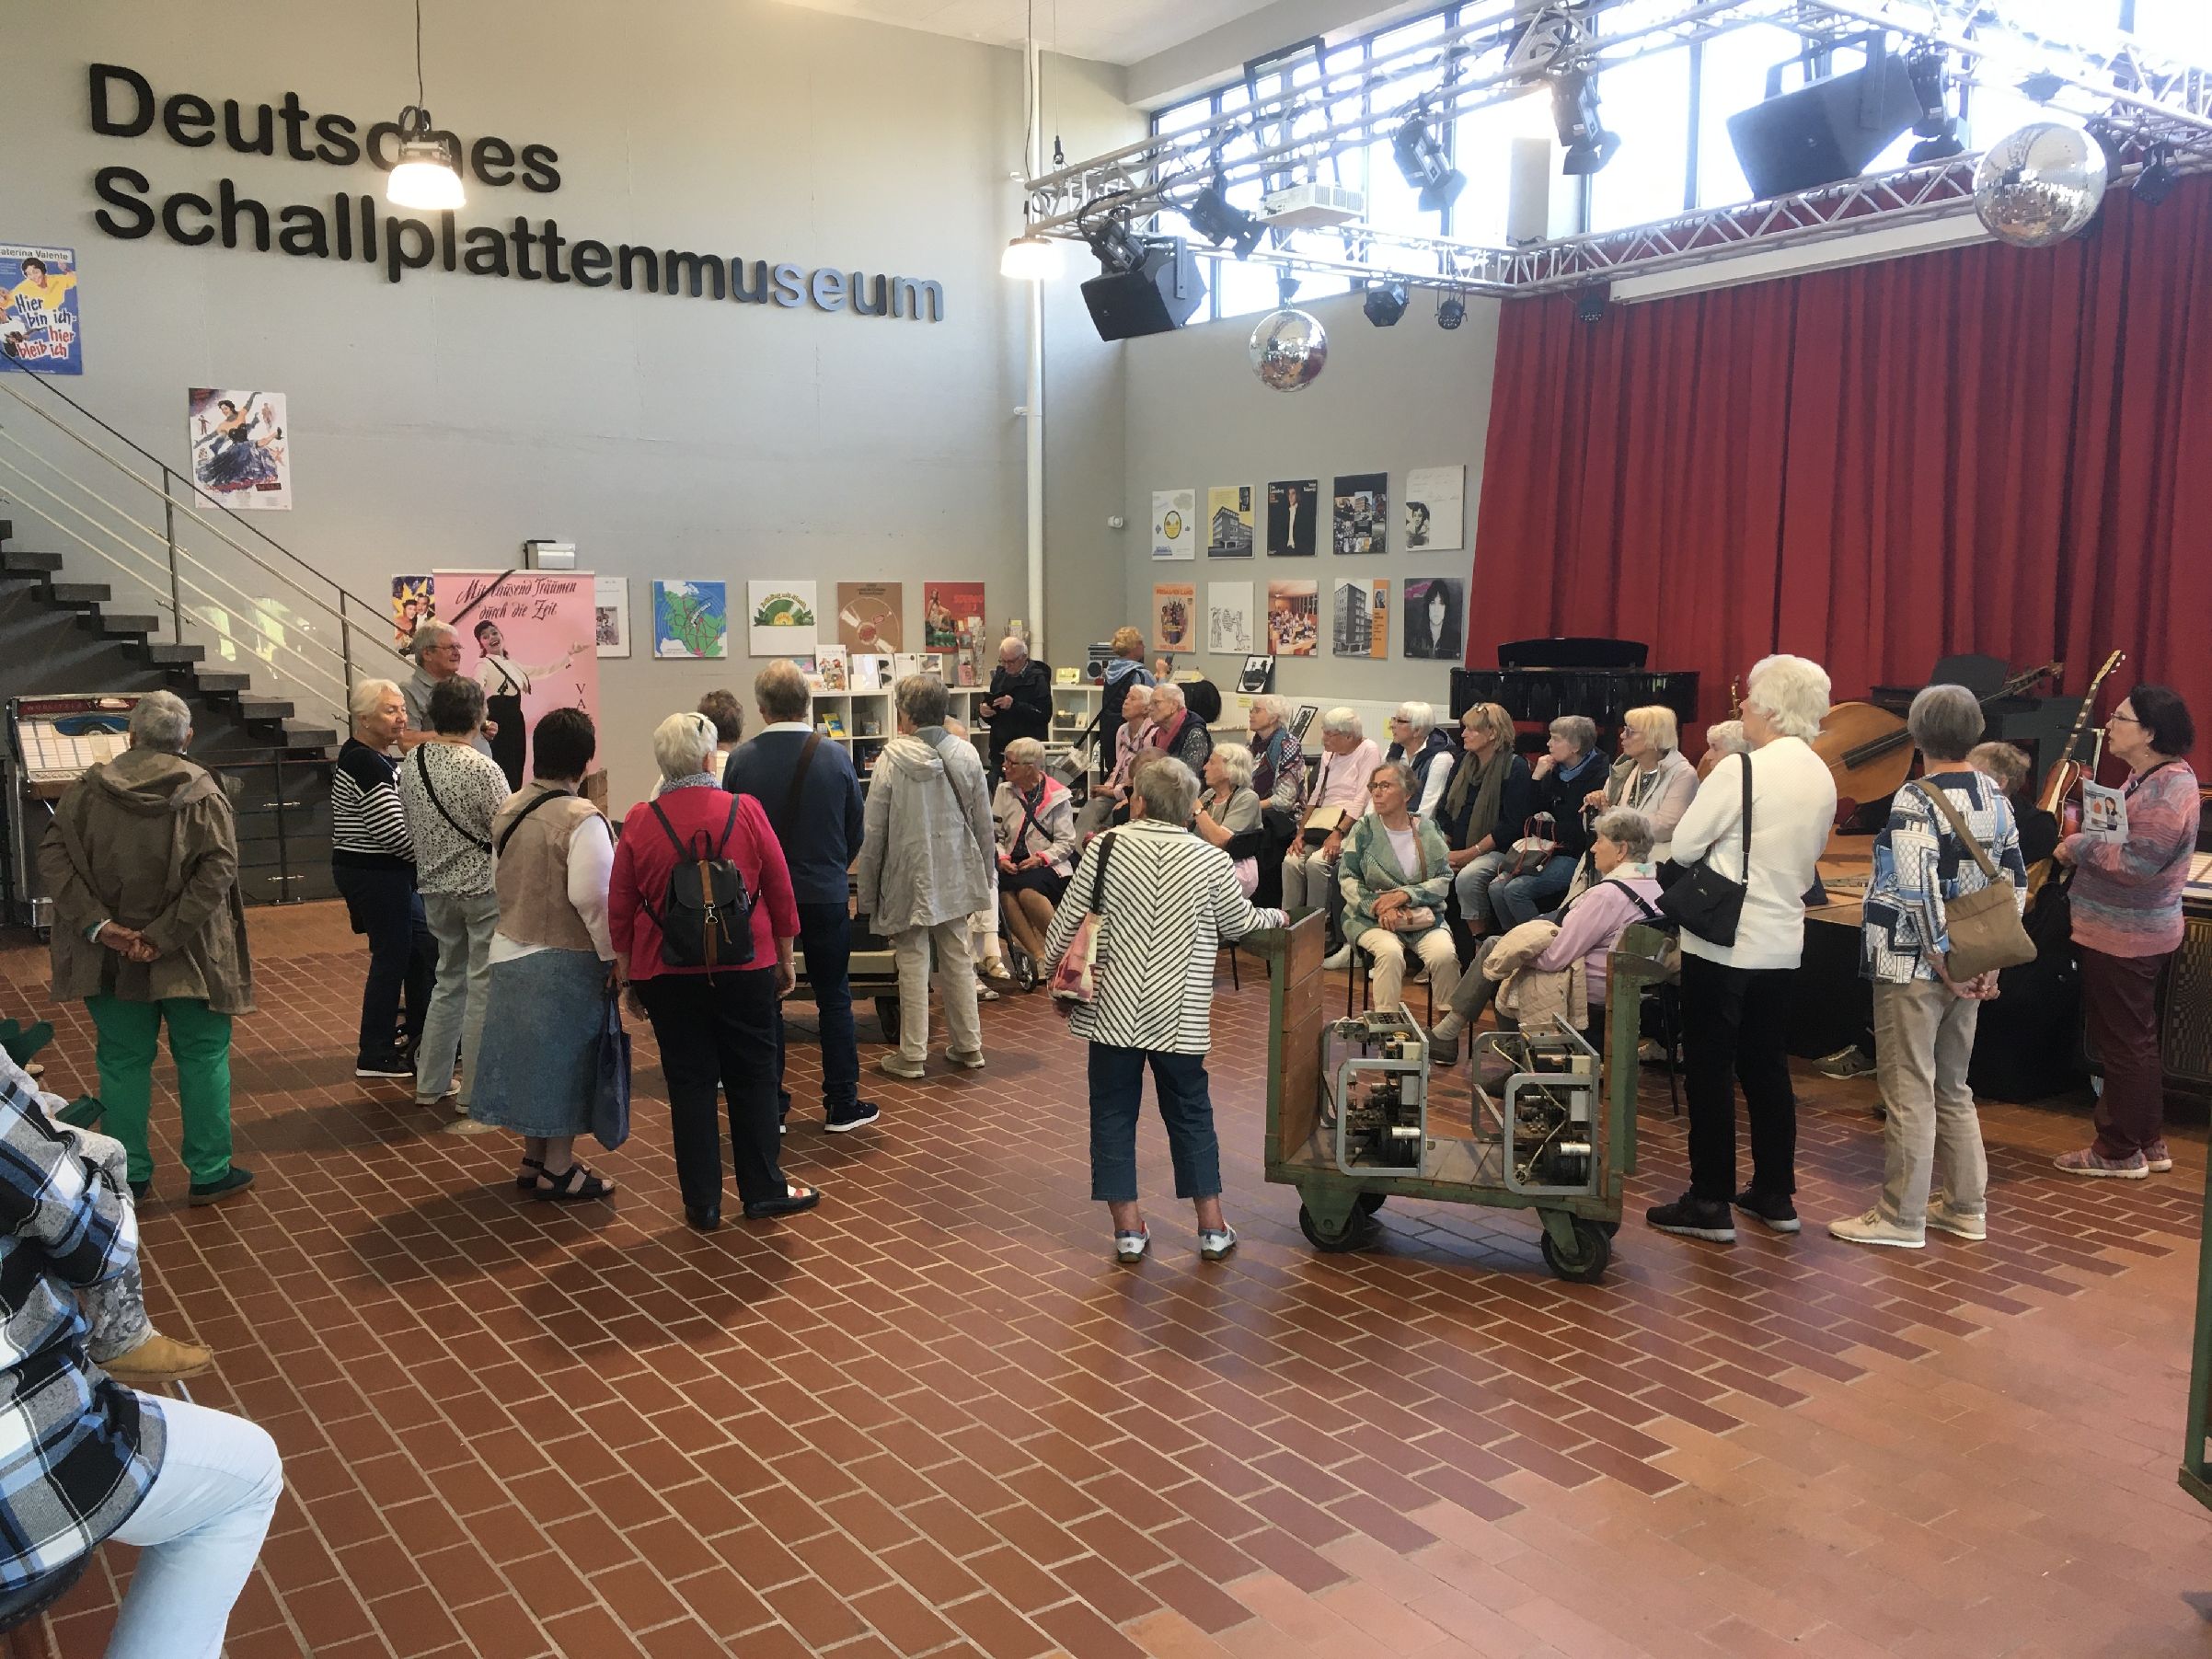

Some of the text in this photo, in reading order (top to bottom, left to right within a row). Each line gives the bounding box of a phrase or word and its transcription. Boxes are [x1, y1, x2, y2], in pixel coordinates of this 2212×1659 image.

[89, 63, 561, 193] Deutsches
[94, 166, 944, 322] Schallplattenmuseum
[35, 249, 68, 260] Valente
[15, 294, 44, 314] Hier
[27, 312, 48, 328] bin
[49, 325, 75, 343] hier
[16, 341, 67, 359] bleib ich
[478, 599, 558, 621] durch die Zeit
